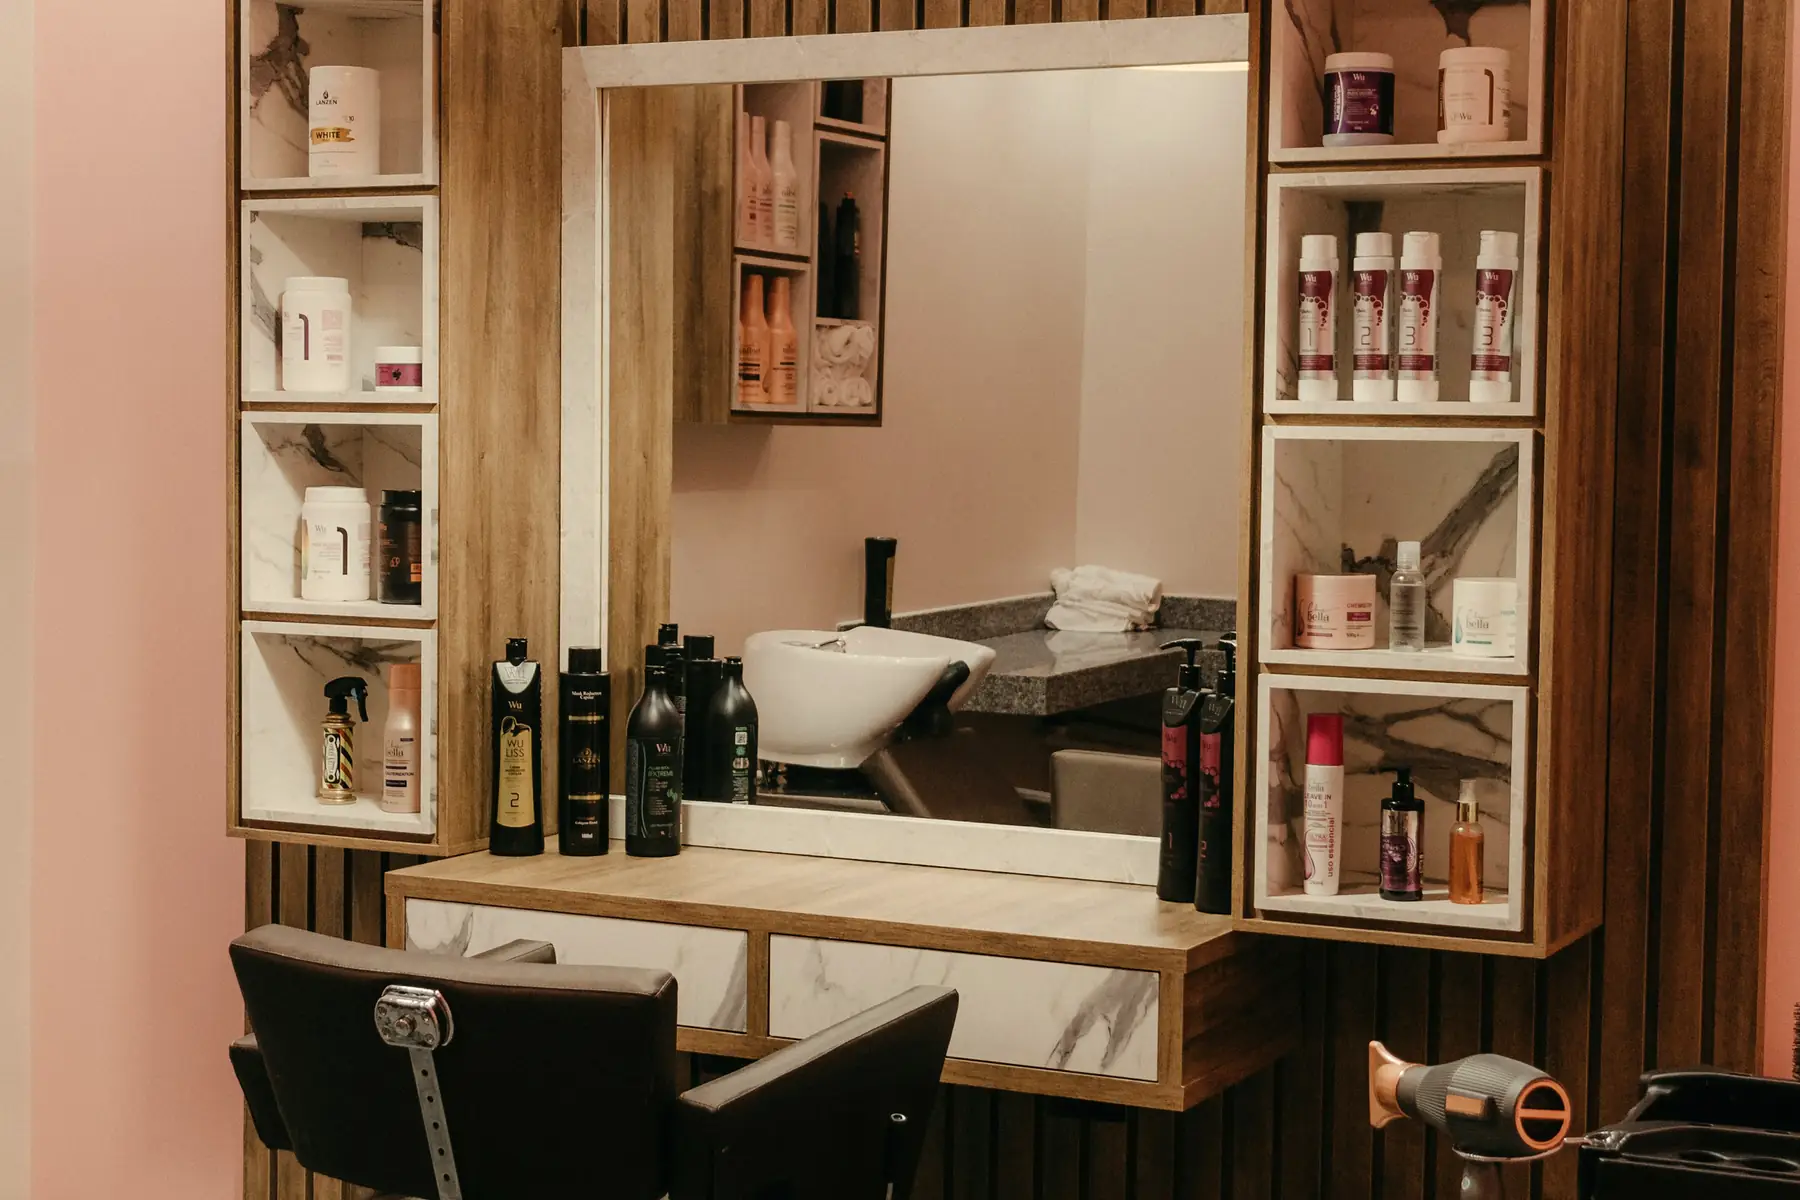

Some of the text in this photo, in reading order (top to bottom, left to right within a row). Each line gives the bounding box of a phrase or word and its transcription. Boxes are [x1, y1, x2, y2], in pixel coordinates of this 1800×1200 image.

[1353, 73, 1366, 81] Wu
[1460, 112, 1472, 121] Wu
[315, 131, 341, 139] WHITE
[1304, 274, 1317, 283] Wu
[1360, 273, 1373, 282] Wu
[1405, 272, 1419, 281] Wu
[1484, 271, 1499, 281] Wu
[1360, 326, 1371, 346] 2
[1404, 326, 1416, 346] 3
[1482, 326, 1494, 346] 3
[1308, 611, 1329, 622] bella
[1466, 618, 1489, 629] bella
[508, 700, 522, 709] Wu
[507, 738, 524, 748] WU
[656, 743, 671, 753] Wu
[505, 747, 525, 758] LISS
[510, 792, 520, 808] 2
[1304, 792, 1321, 800] LEAVE
